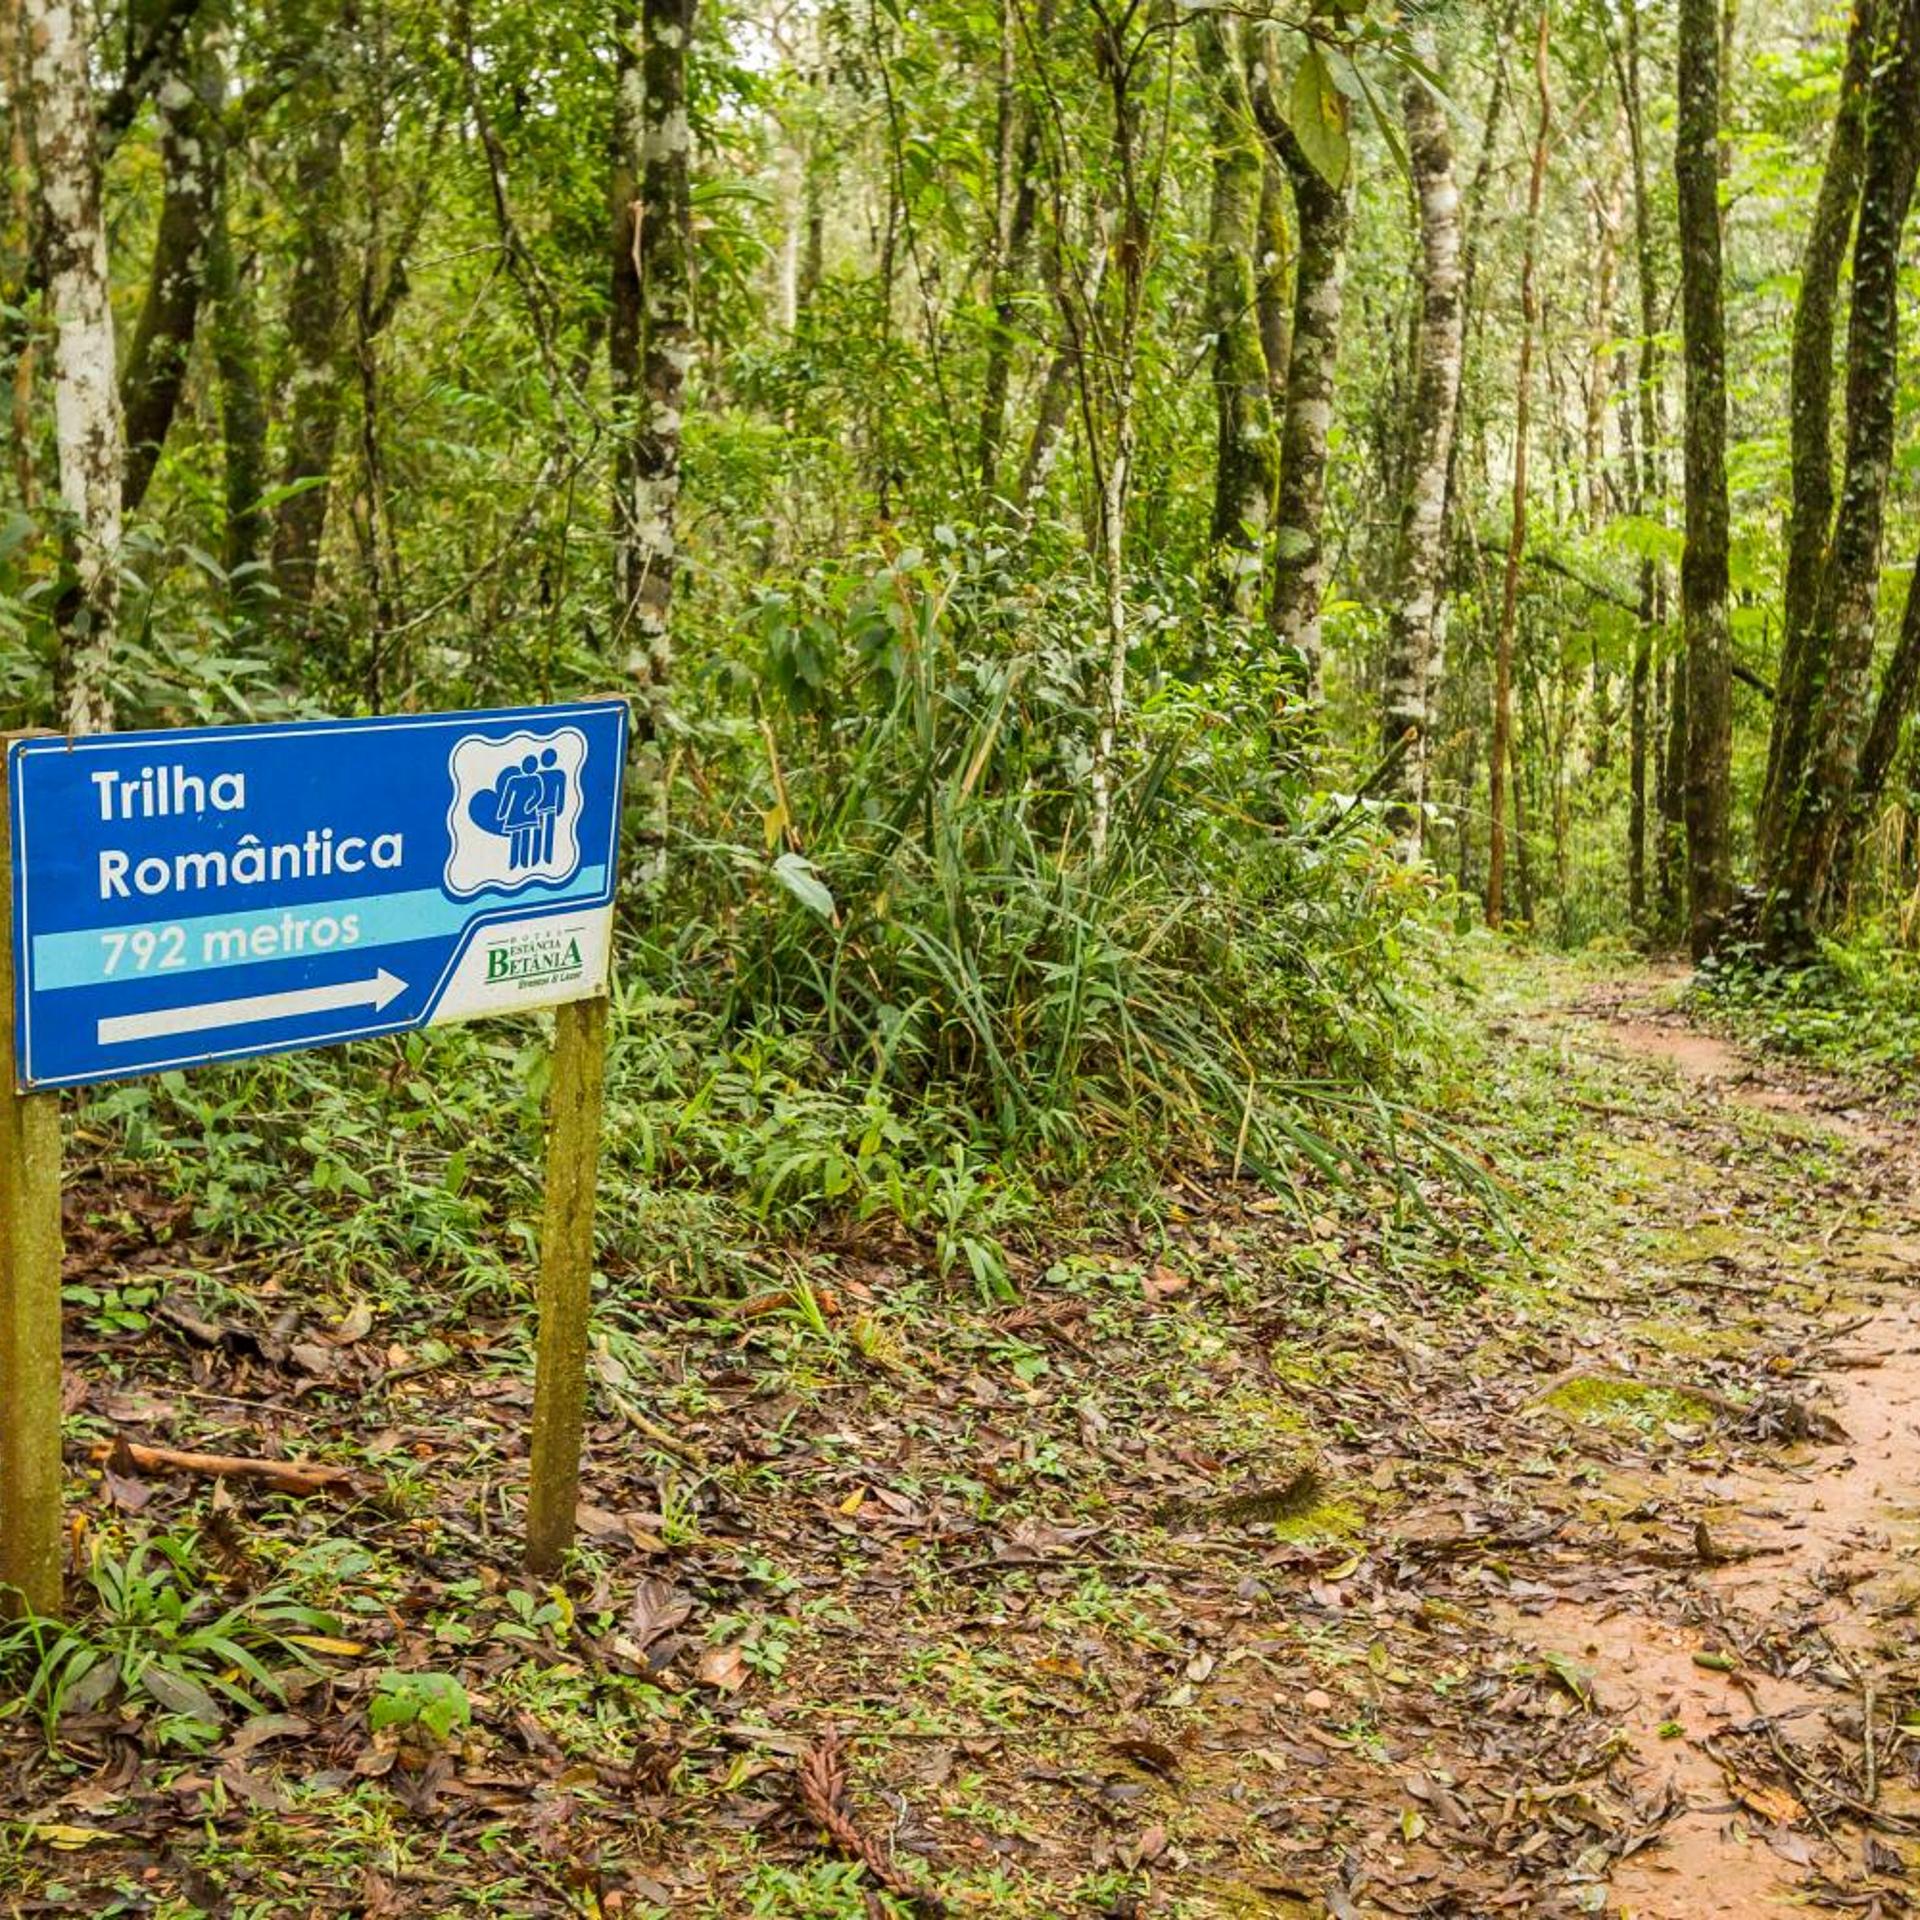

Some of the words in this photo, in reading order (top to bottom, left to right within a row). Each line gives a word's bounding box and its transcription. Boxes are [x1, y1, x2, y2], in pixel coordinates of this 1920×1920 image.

[91, 765, 245, 821] Trilha
[99, 827, 403, 899] Romântica
[101, 925, 187, 976] 792
[203, 913, 360, 962] metros
